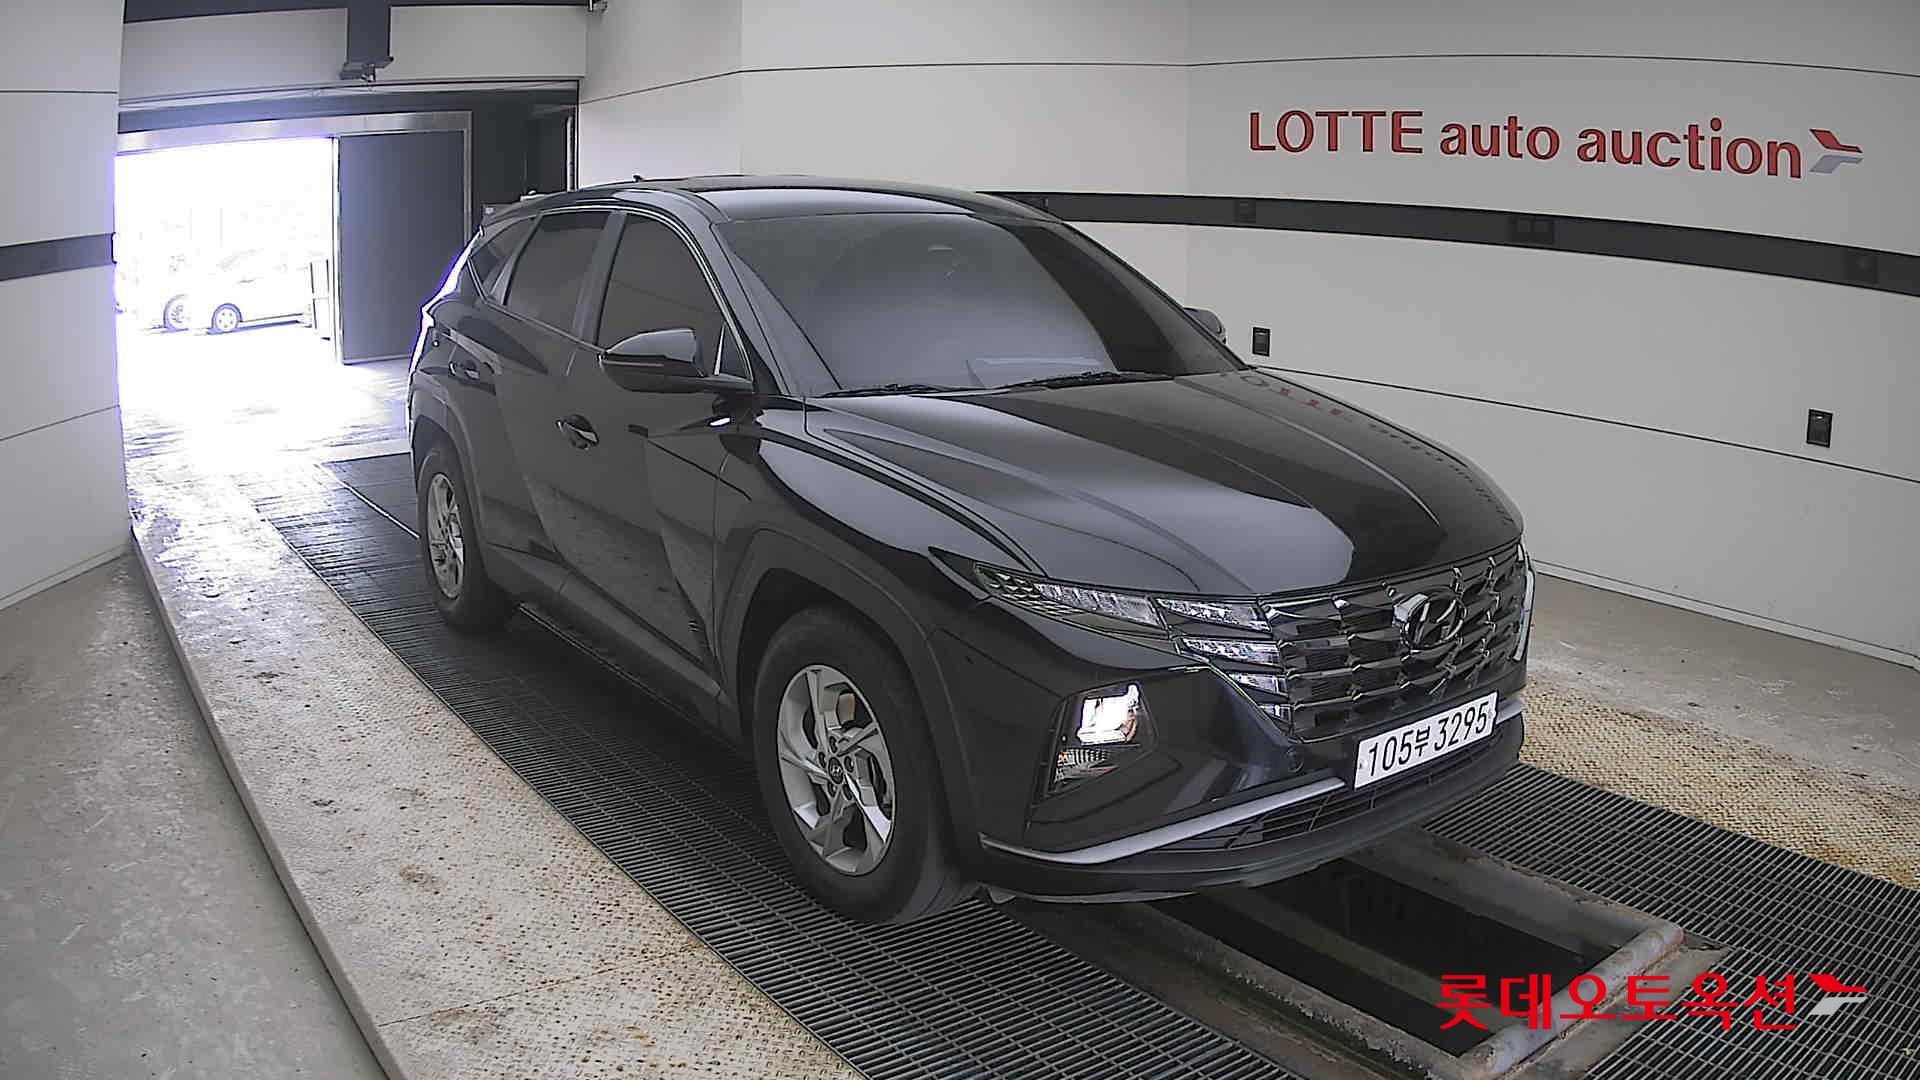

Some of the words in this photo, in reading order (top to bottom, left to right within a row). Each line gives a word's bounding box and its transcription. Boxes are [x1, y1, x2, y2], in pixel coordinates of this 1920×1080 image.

[1248, 111, 1424, 155] LOTTE
[1441, 115, 1561, 161] auto
[1576, 117, 1804, 178] auction
